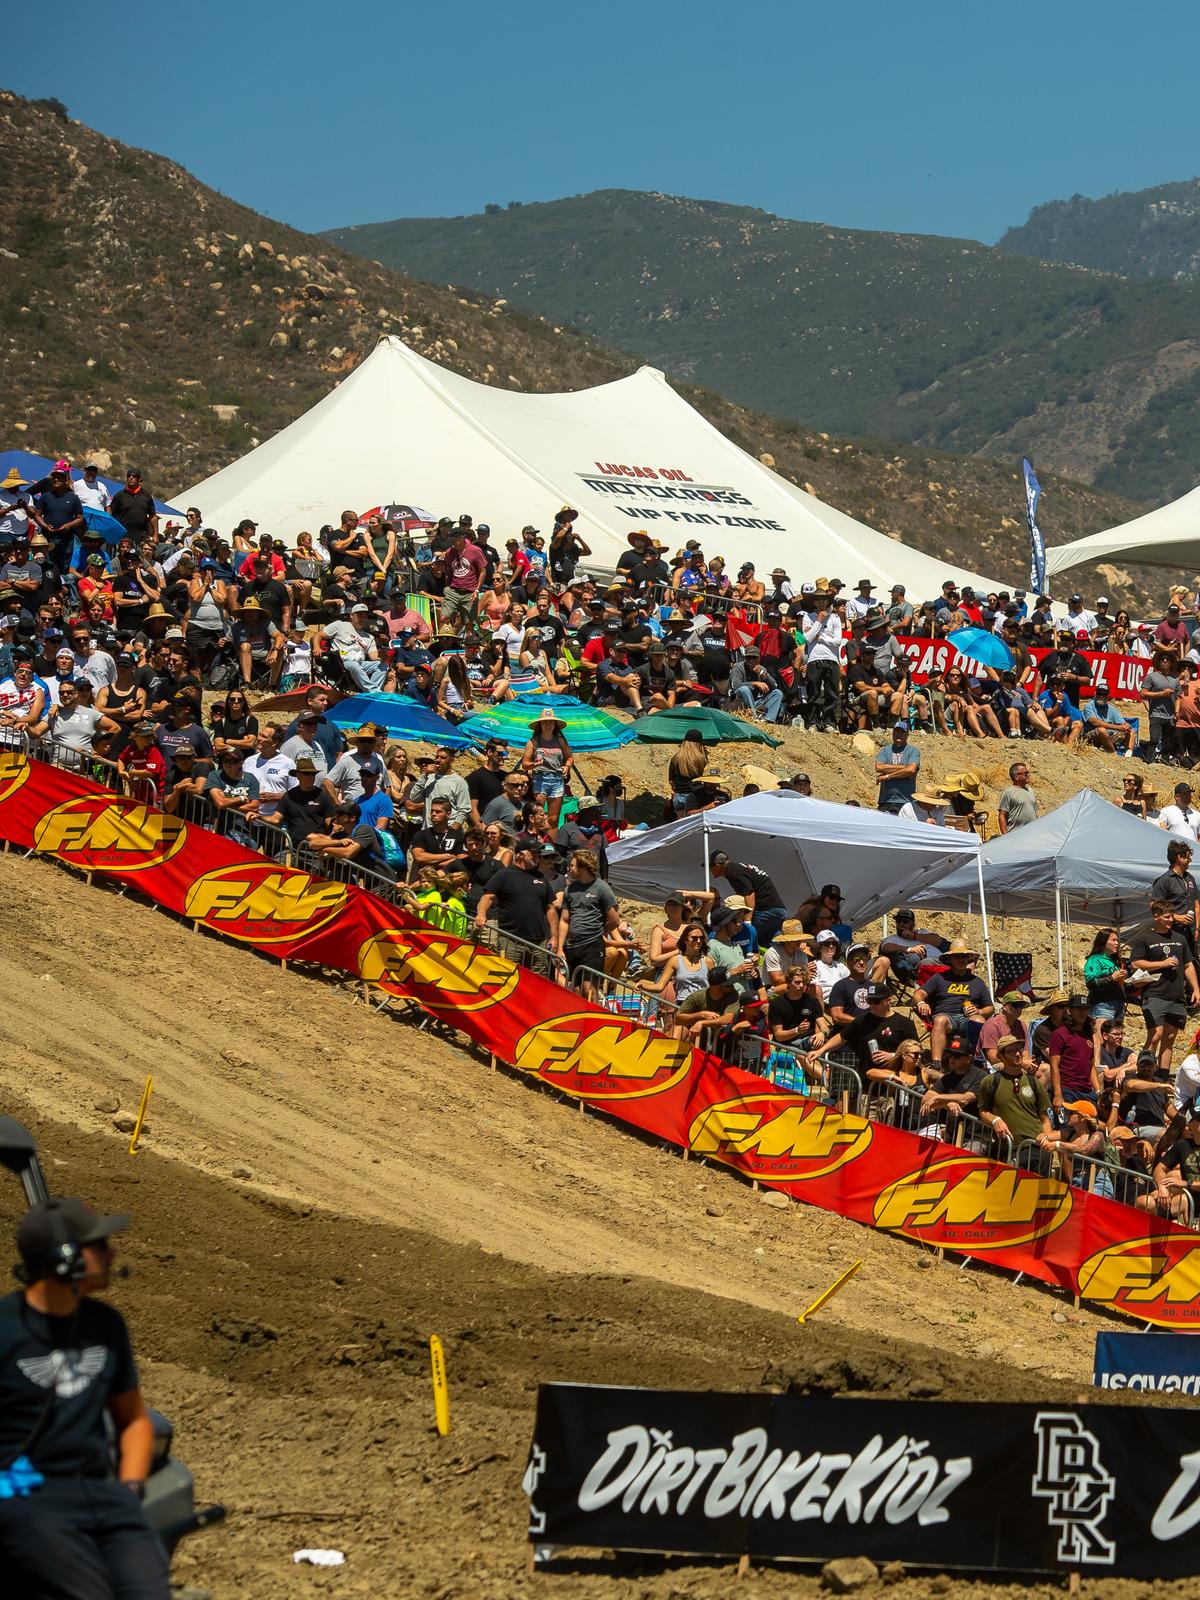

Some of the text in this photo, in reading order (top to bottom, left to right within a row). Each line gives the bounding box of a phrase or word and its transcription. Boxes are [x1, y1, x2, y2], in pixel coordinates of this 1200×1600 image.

[595, 462, 694, 482] LUCAS OIL
[582, 479, 753, 505] MOTOCROSS
[614, 505, 787, 531] VIP FAN ZONE
[705, 639, 725, 647] YAMAHA
[35, 805, 186, 853] FMF
[187, 874, 348, 921] FMF
[948, 983, 970, 994] CAL
[516, 1026, 690, 1079] FMF
[690, 1105, 869, 1158] FMF
[875, 1169, 1069, 1229] FMF
